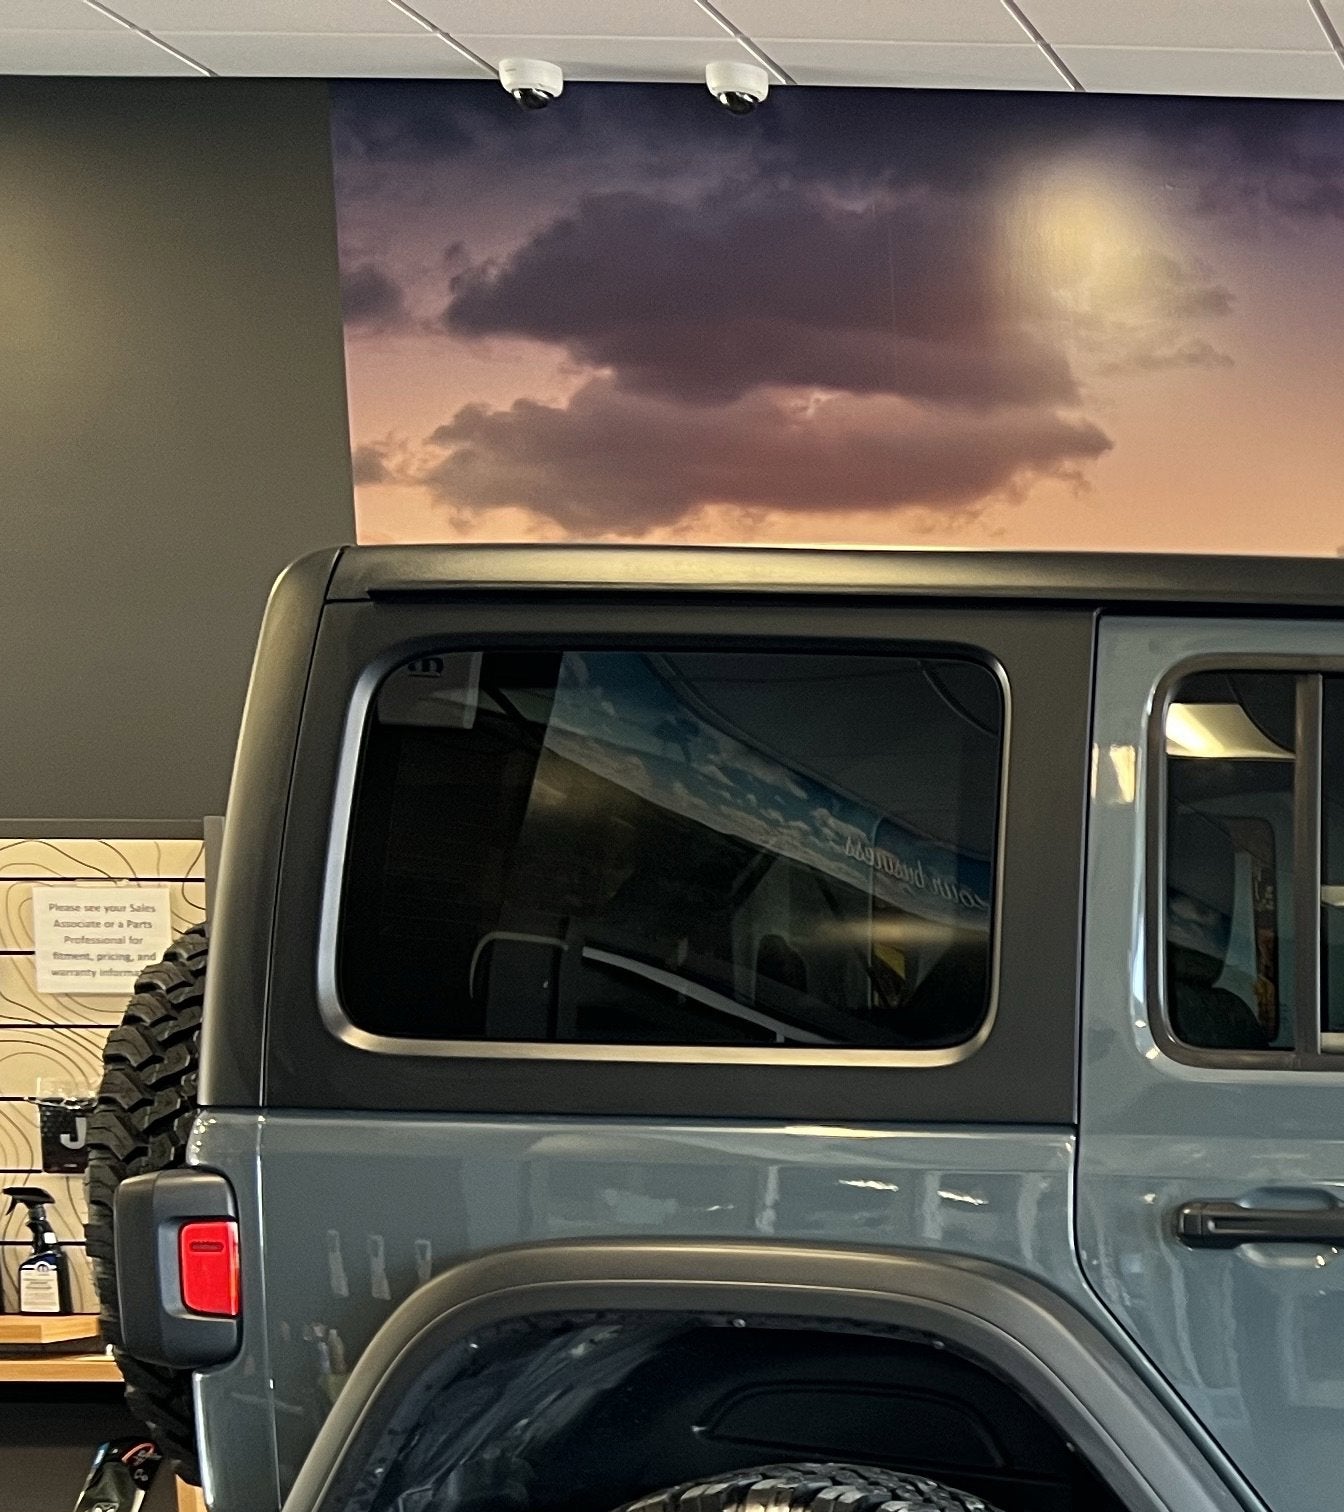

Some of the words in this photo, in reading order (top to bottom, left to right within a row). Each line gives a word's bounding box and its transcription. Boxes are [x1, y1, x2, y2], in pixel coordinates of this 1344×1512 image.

[48, 903, 81, 912] Please
[103, 905, 127, 913] your
[129, 903, 156, 913] Sales
[53, 919, 101, 928] Associate
[126, 919, 153, 928] Parts
[64, 935, 126, 944] Professional
[128, 935, 143, 944] for
[53, 951, 94, 961] fitment,
[96, 952, 134, 962] pricing,
[137, 952, 156, 961] and
[51, 969, 97, 978] warranty
